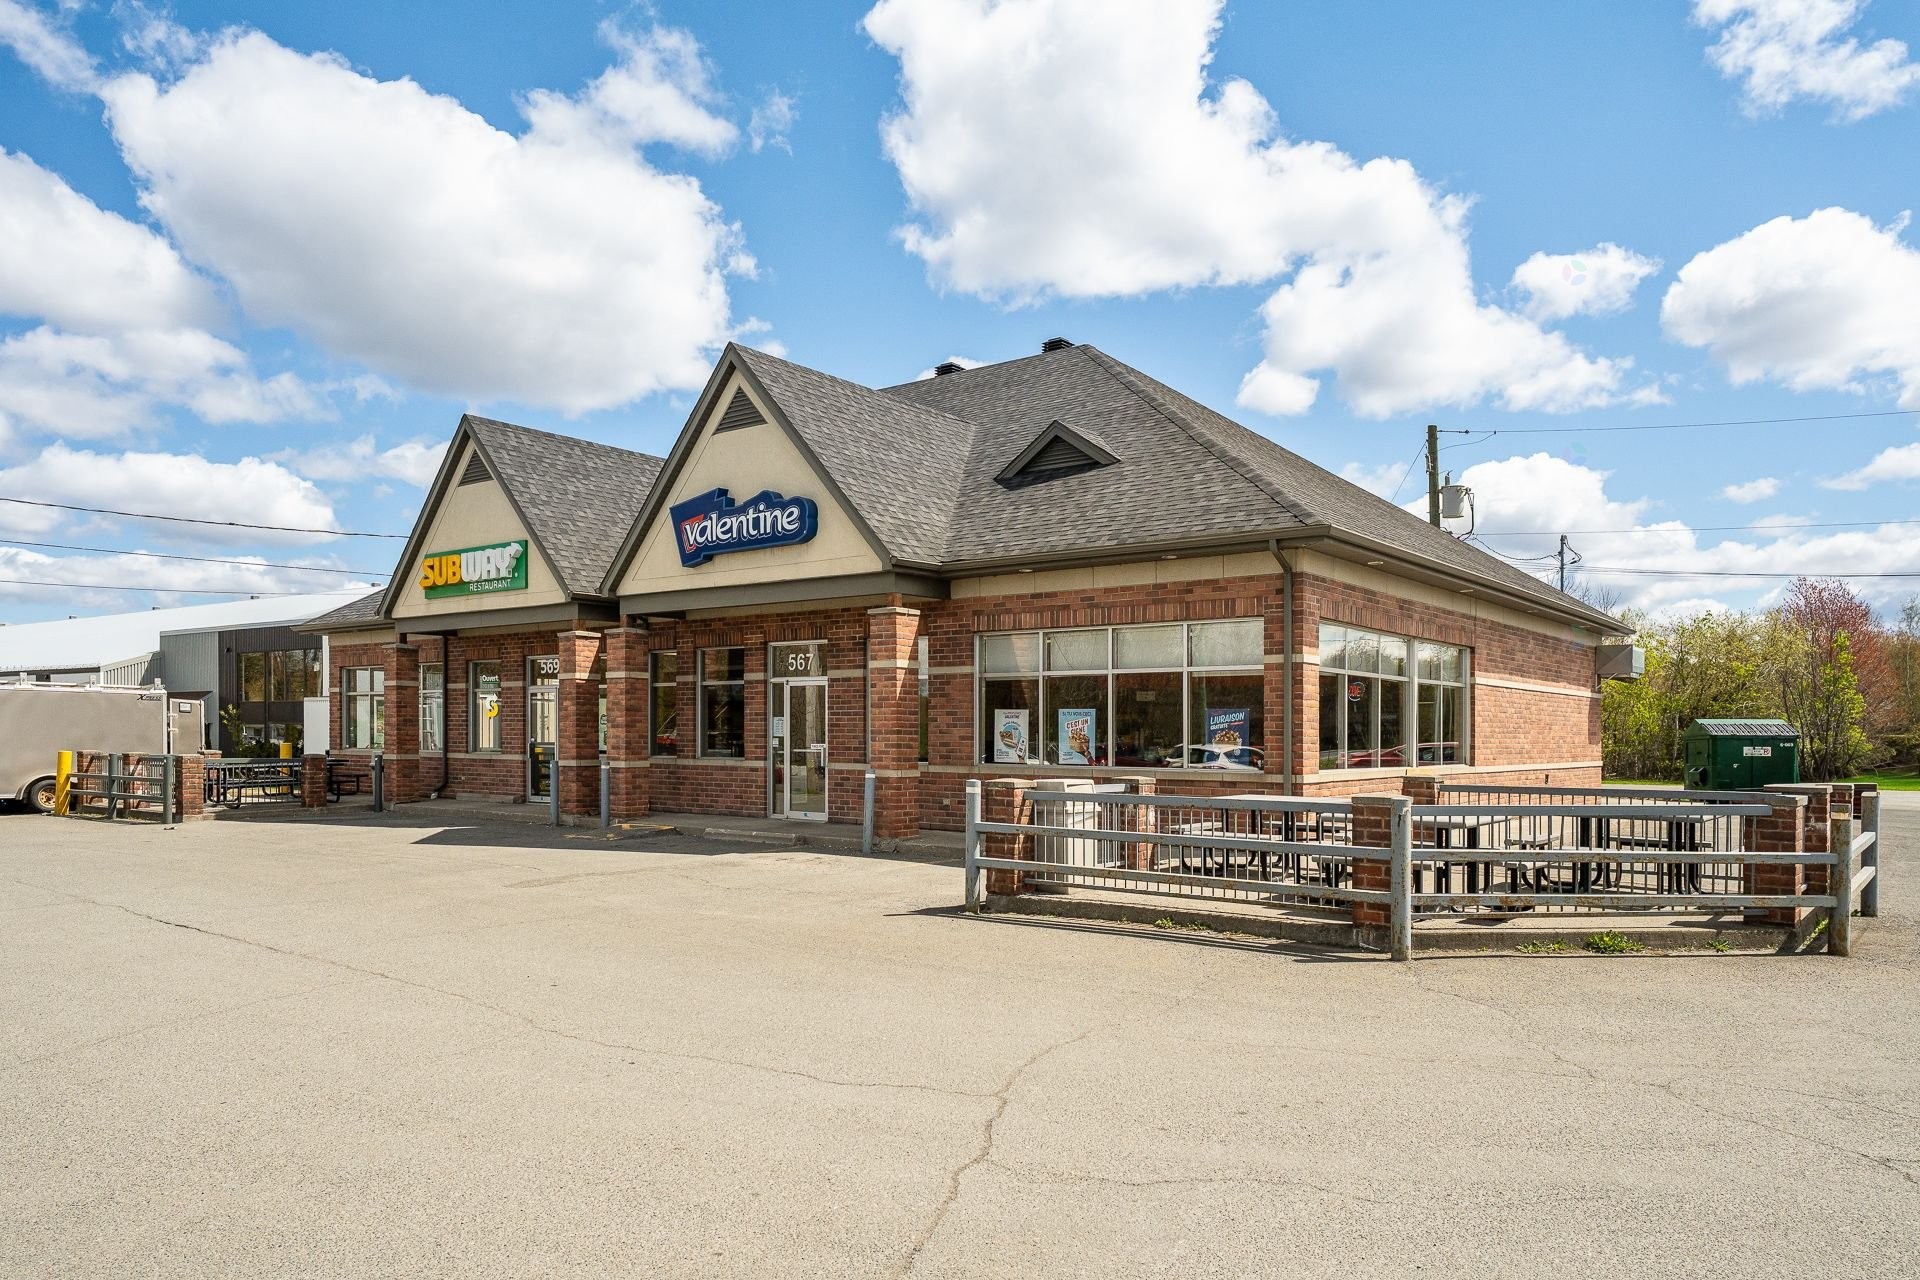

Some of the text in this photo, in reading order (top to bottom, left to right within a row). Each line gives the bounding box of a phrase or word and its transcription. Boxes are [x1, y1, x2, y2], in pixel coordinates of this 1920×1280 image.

[684, 502, 800, 549] valentine
[420, 543, 522, 589] SUBWAY
[469, 579, 511, 592] RESTAURANT
[540, 659, 560, 674] 569
[788, 653, 814, 671] 567
[1081, 718, 1089, 726] UN
[1210, 711, 1245, 725] LIVRAISON
